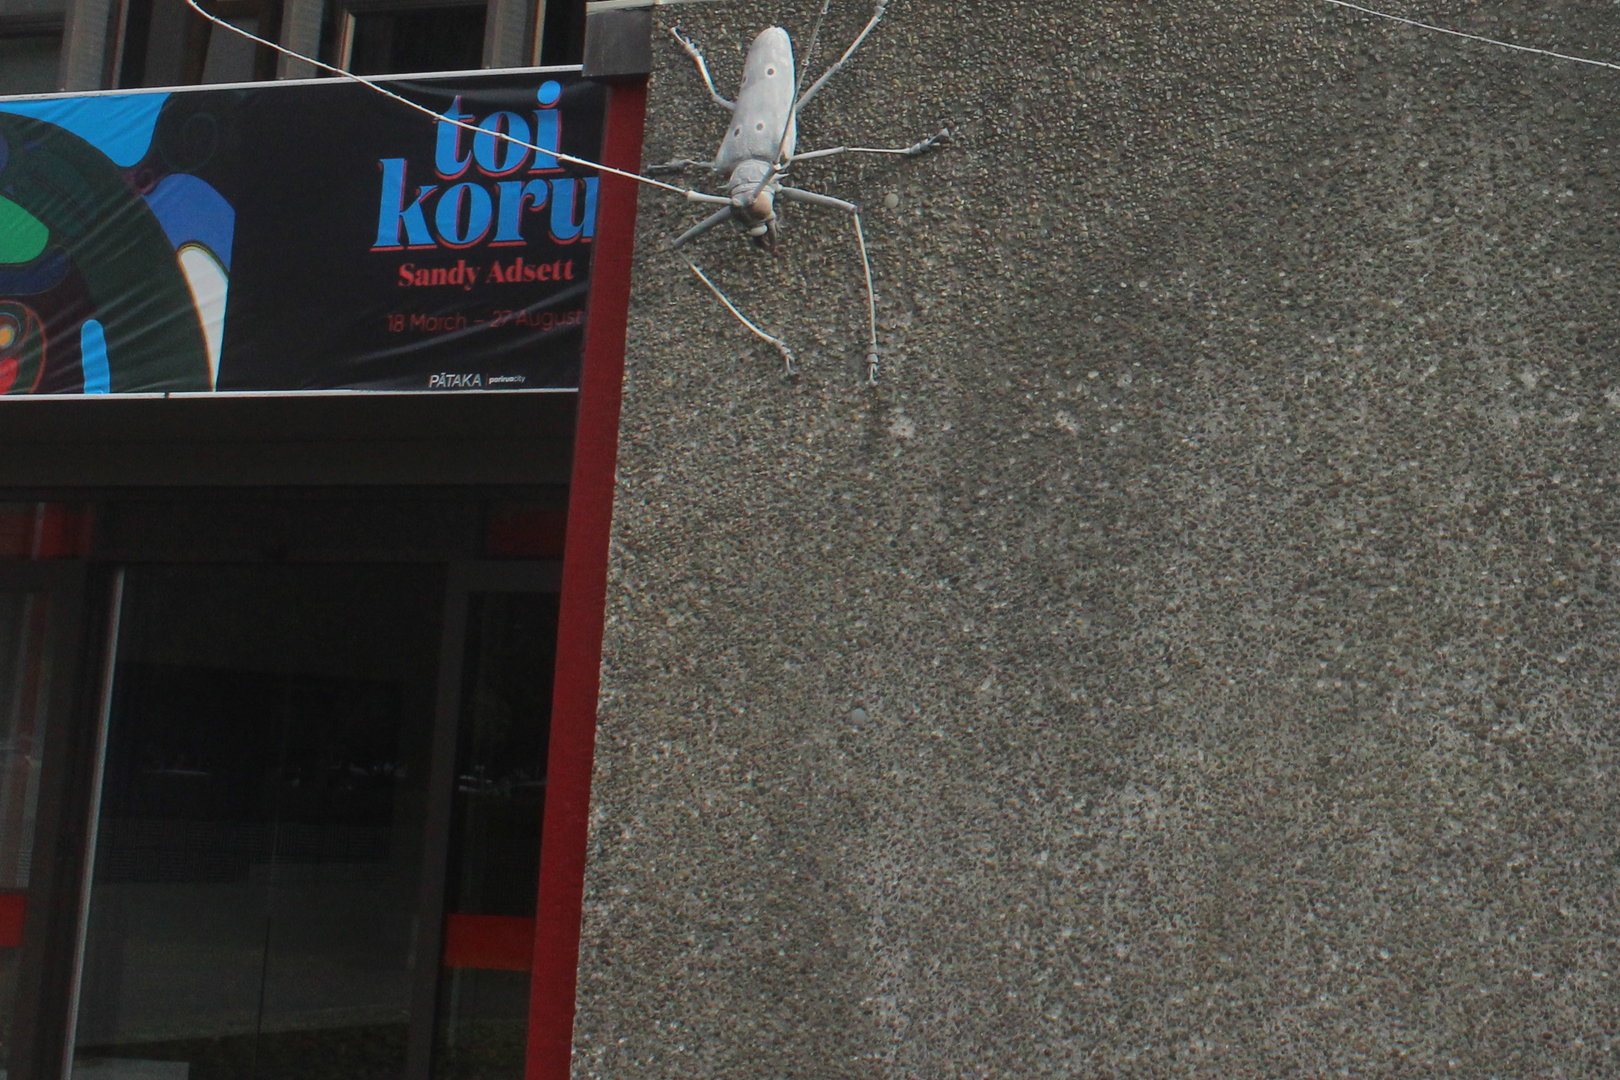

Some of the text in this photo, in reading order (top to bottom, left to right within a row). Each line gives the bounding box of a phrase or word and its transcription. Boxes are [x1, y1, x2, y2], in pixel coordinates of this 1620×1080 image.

[433, 80, 565, 180] toi
[369, 157, 599, 252] koru
[397, 257, 575, 291] Sandy Adsett
[387, 313, 405, 333] 18
[410, 312, 467, 332] March
[516, 309, 585, 331] August
[429, 372, 482, 388] PĀTAKA
